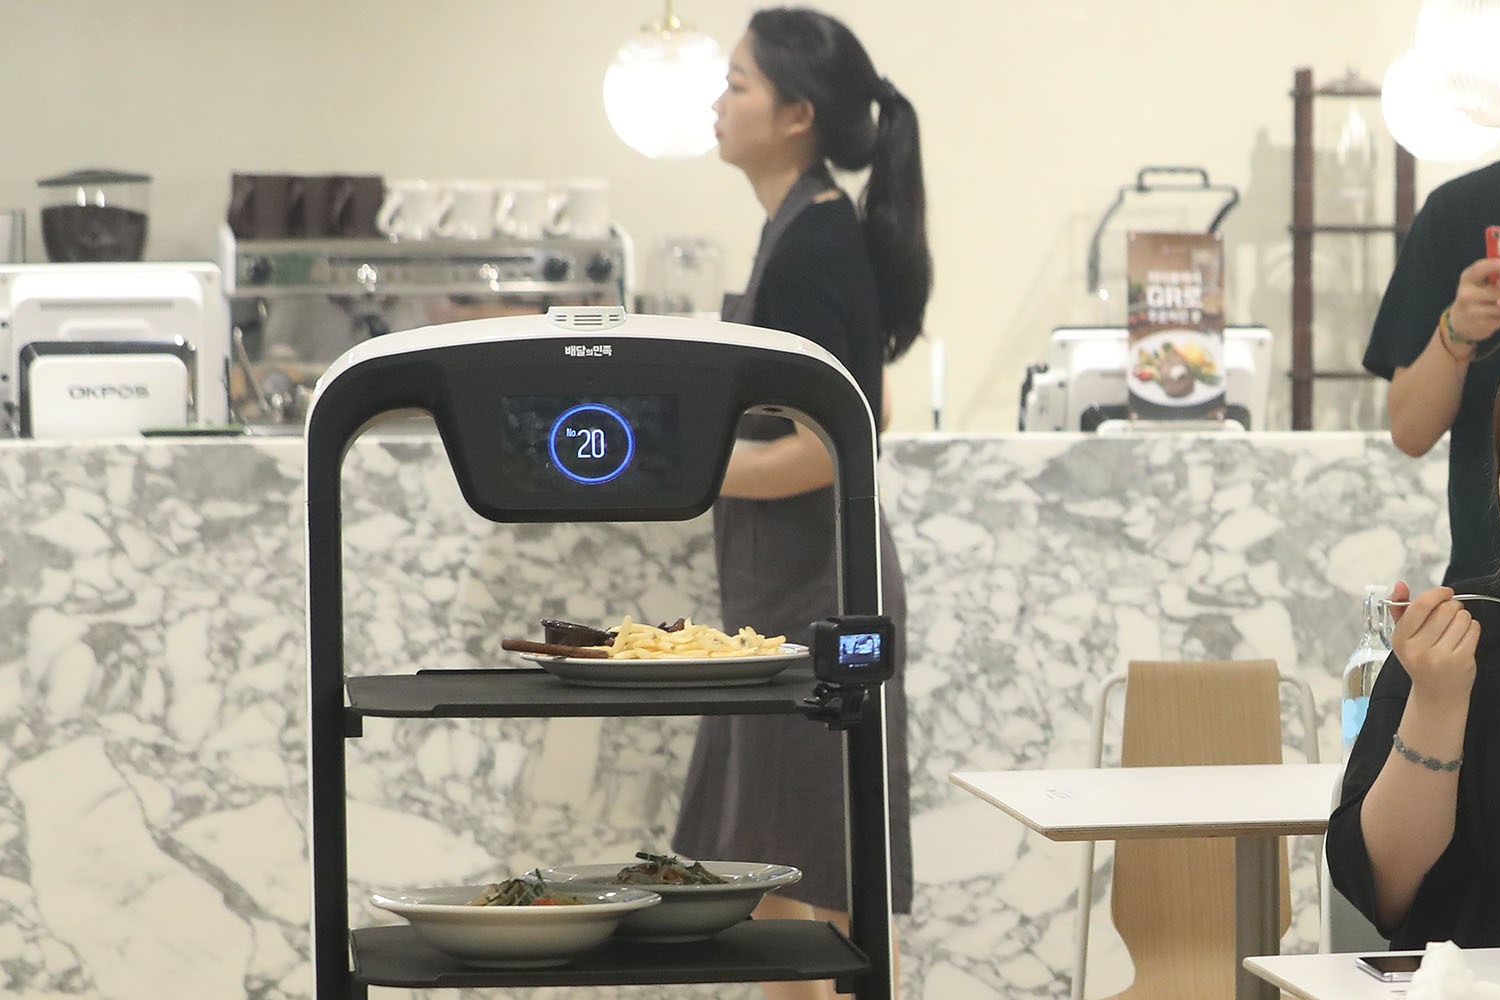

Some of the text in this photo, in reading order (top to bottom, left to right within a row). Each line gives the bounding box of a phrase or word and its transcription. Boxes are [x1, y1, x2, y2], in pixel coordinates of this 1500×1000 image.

[564, 345, 613, 358] 배달의민족
[68, 384, 150, 399] OKPOS
[566, 428, 605, 459] No. 20
